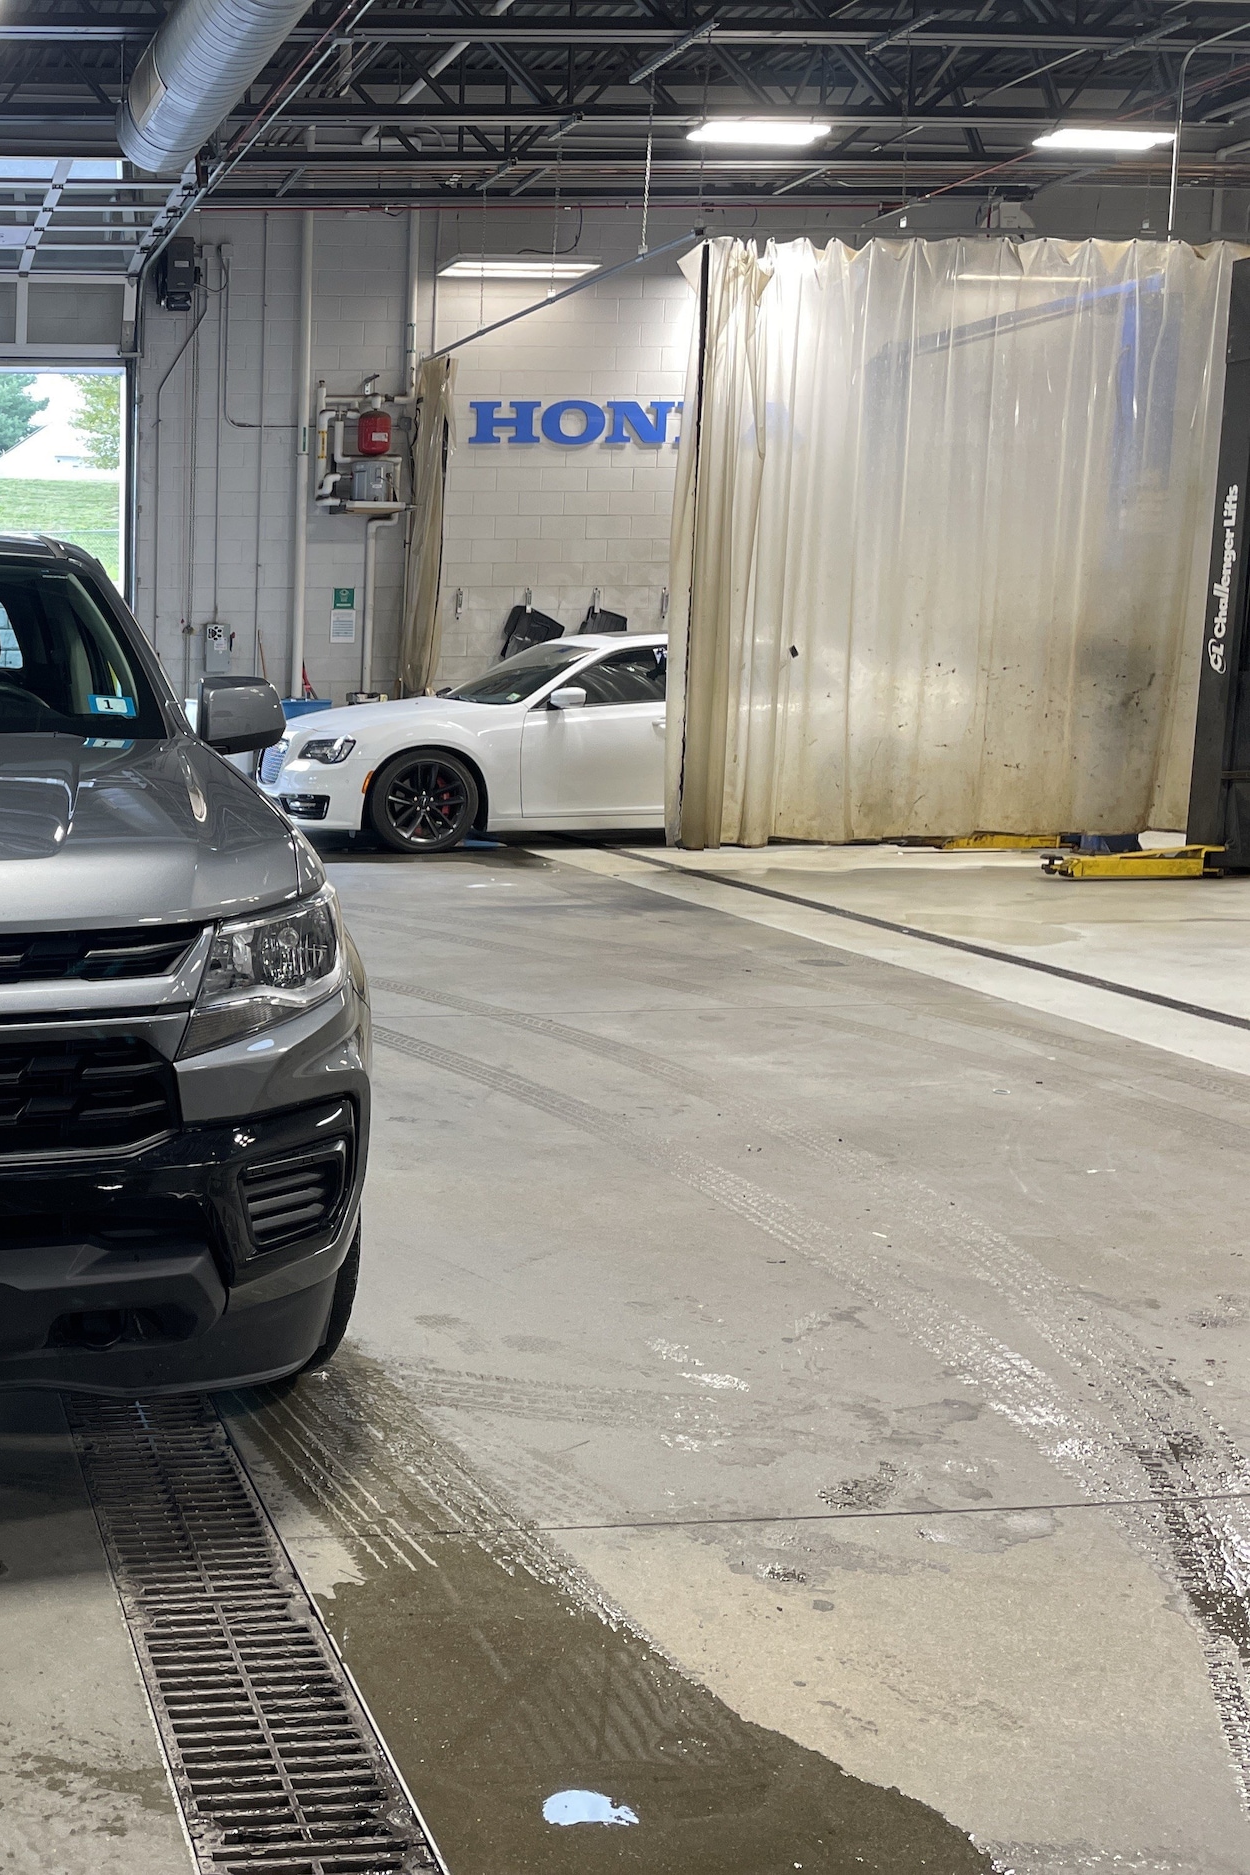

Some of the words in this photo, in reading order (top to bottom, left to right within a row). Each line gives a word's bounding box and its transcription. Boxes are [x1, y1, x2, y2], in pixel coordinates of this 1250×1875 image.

[468, 400, 684, 444] HON
[1223, 484, 1238, 528] Lifts
[1213, 529, 1236, 639] Challenger
[103, 699, 114, 710] 1
